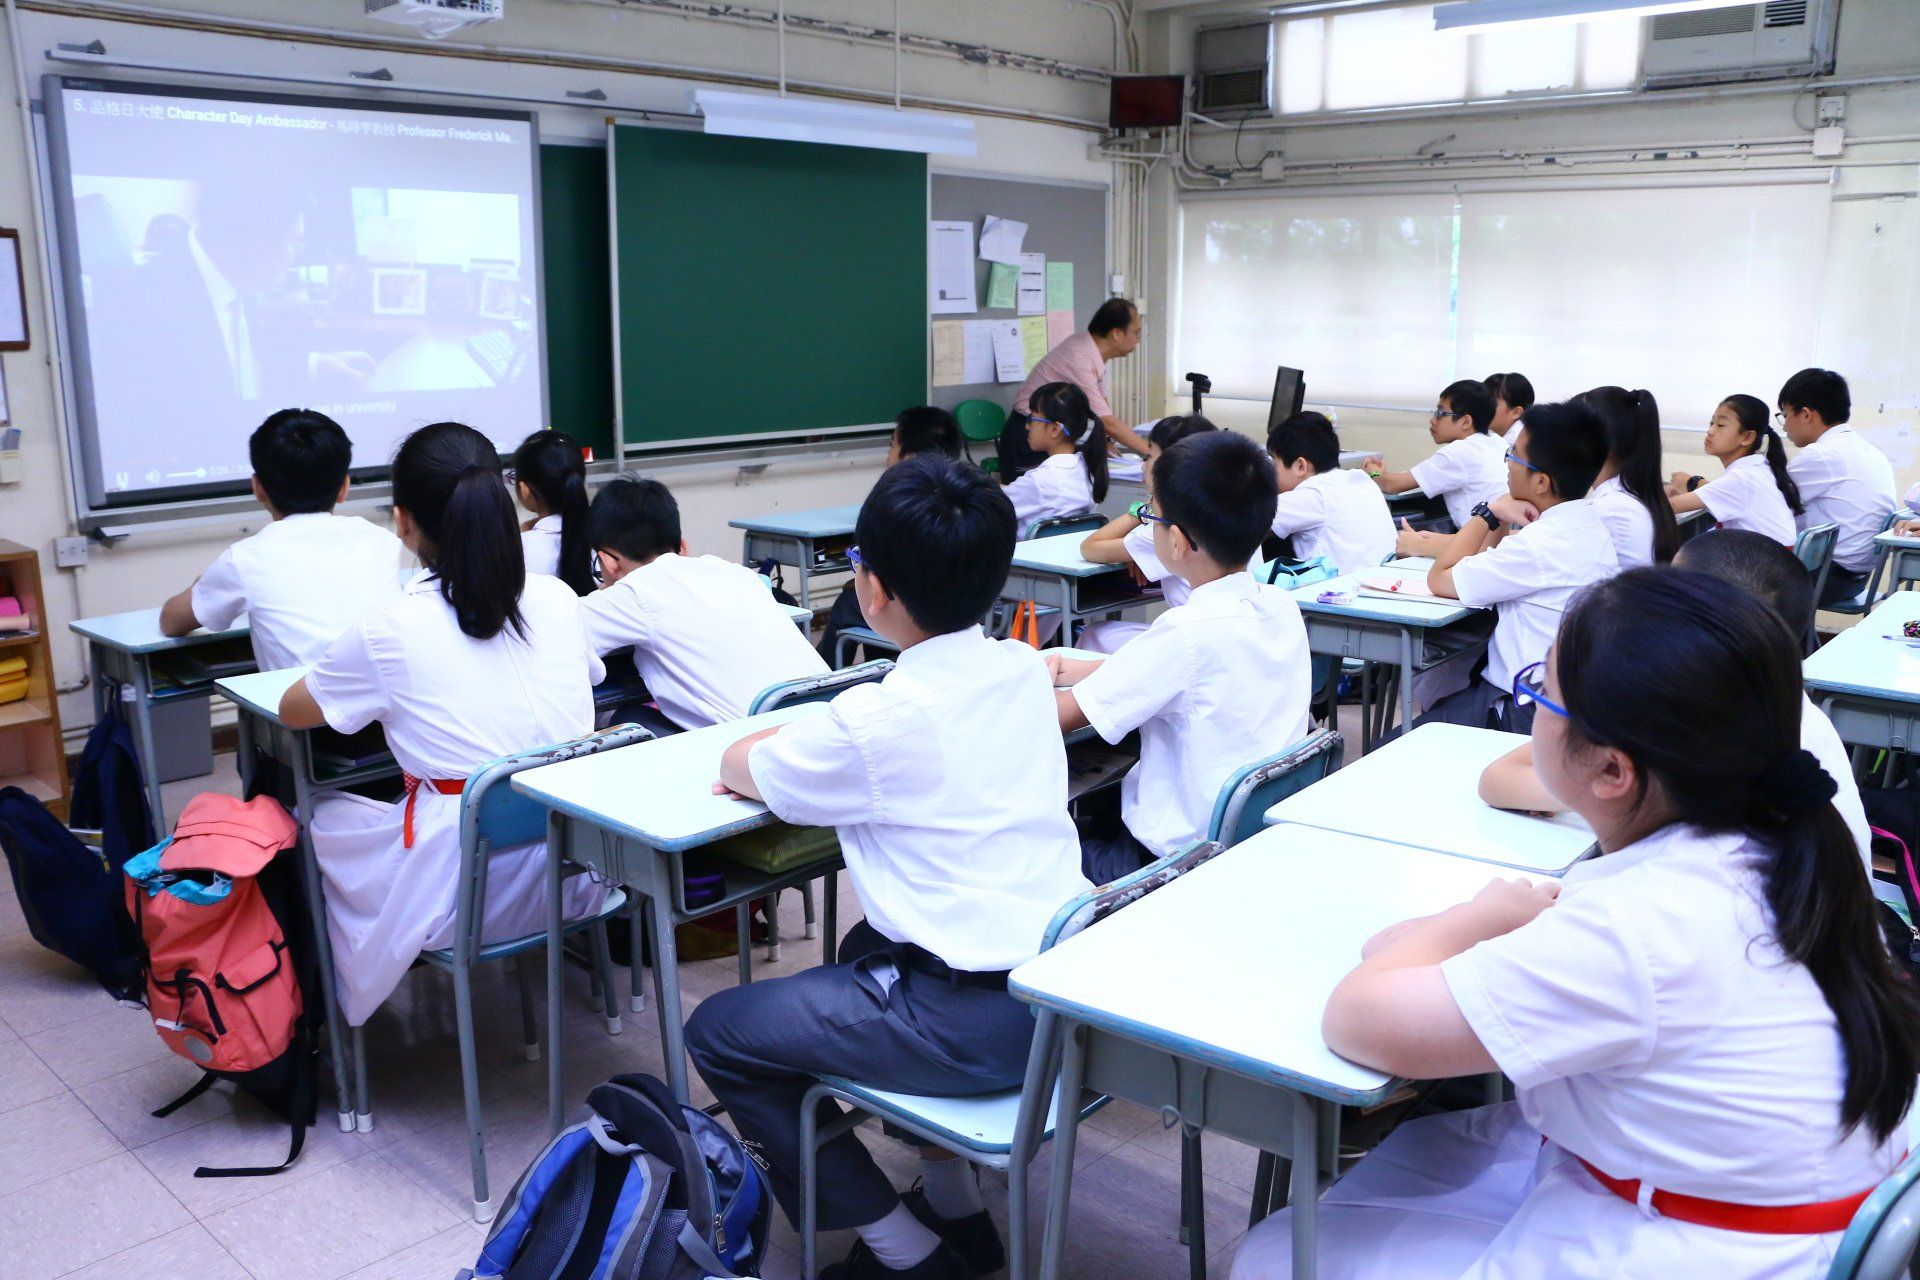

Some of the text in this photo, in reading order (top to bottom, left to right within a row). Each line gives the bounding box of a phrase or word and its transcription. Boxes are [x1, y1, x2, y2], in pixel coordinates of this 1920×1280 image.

[73, 99, 85, 112] 5.
[167, 106, 227, 122] Character
[230, 111, 253, 127] Day
[255, 114, 327, 130] Ambassador
[398, 124, 446, 138] Professor
[449, 128, 493, 142] Frederick
